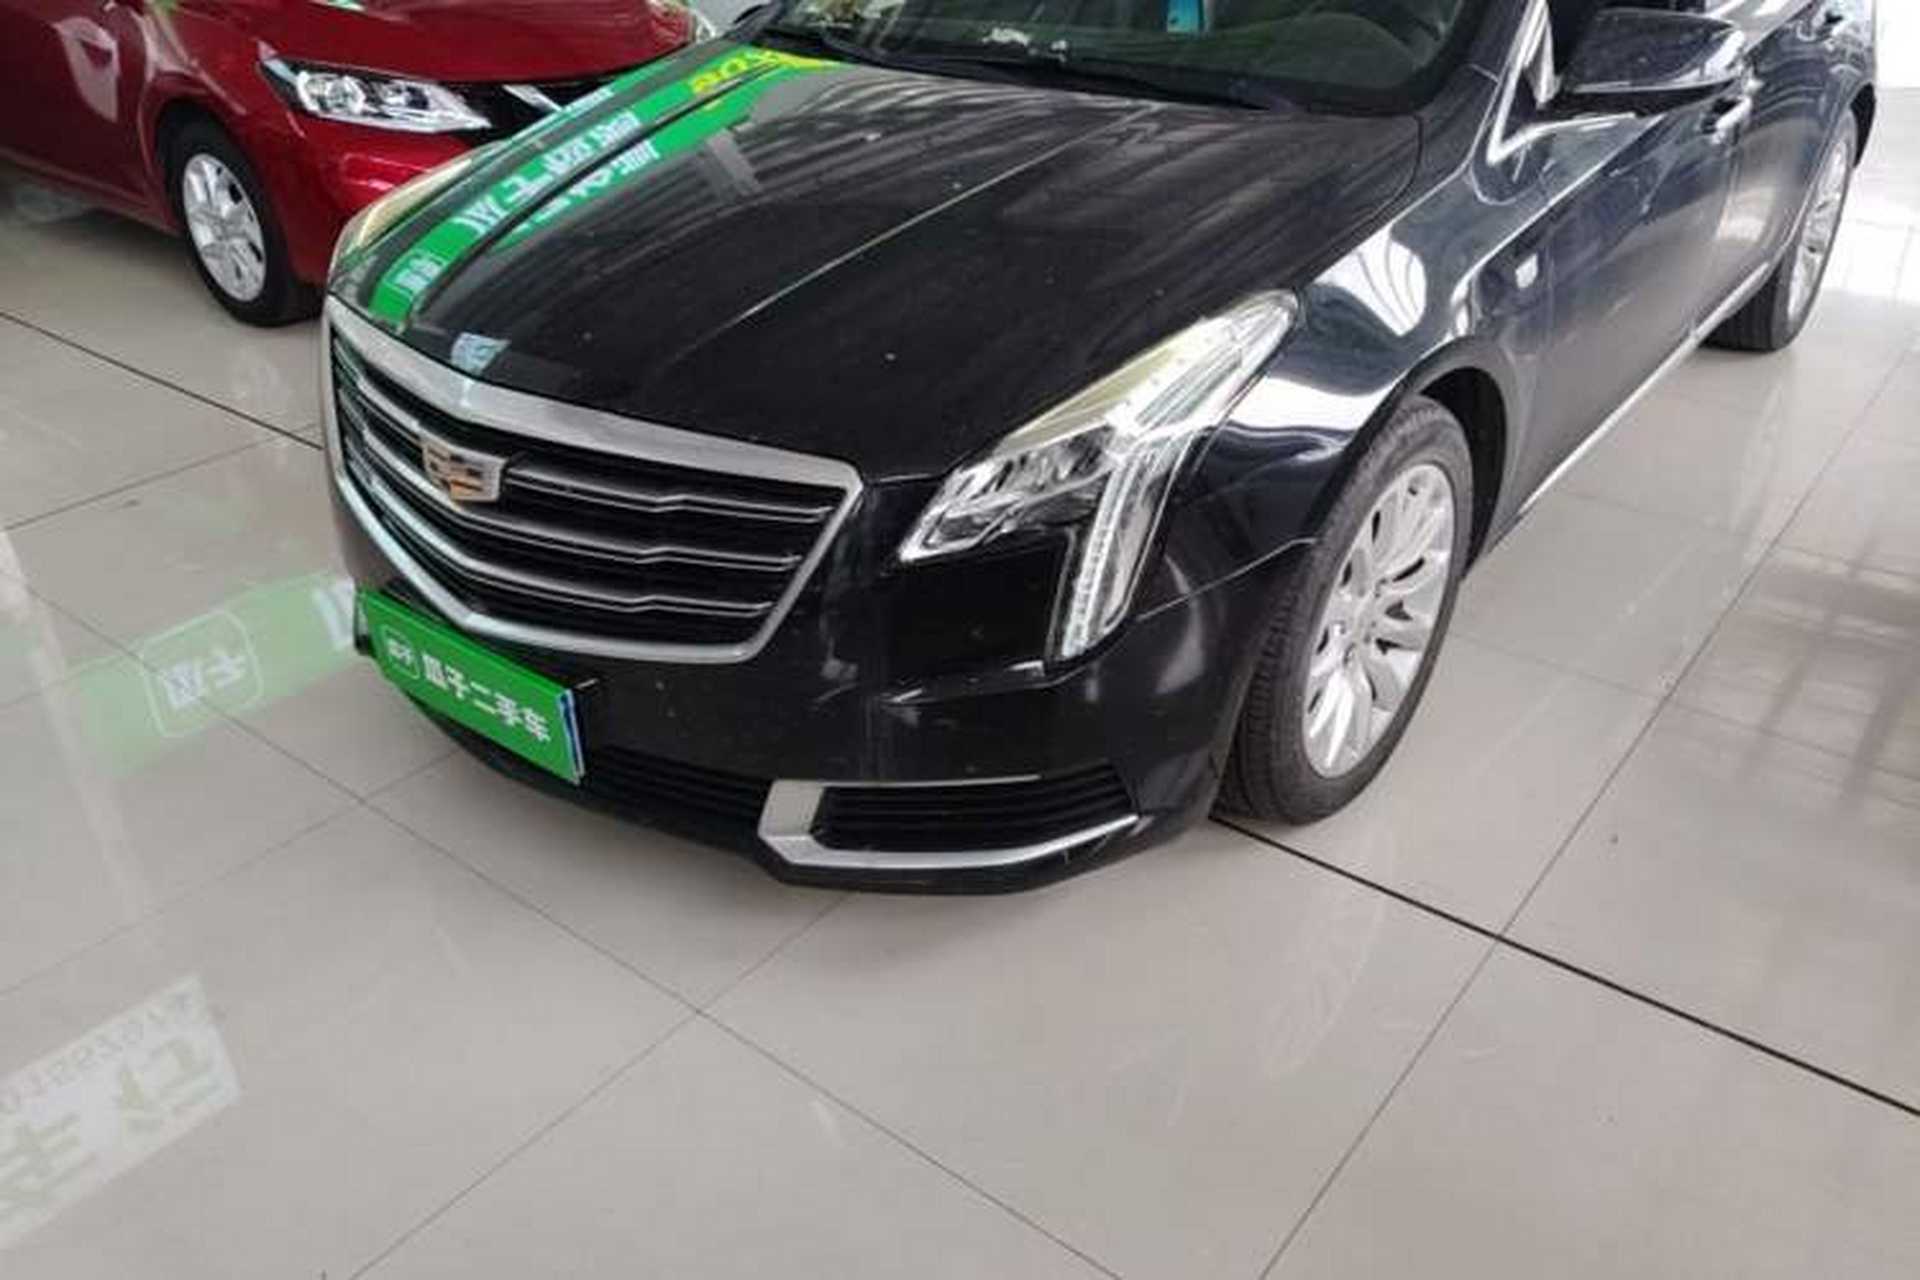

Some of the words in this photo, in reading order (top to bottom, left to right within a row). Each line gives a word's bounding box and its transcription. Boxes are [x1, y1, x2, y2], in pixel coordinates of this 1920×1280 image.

[421, 650, 551, 743] 瓜子二手车
